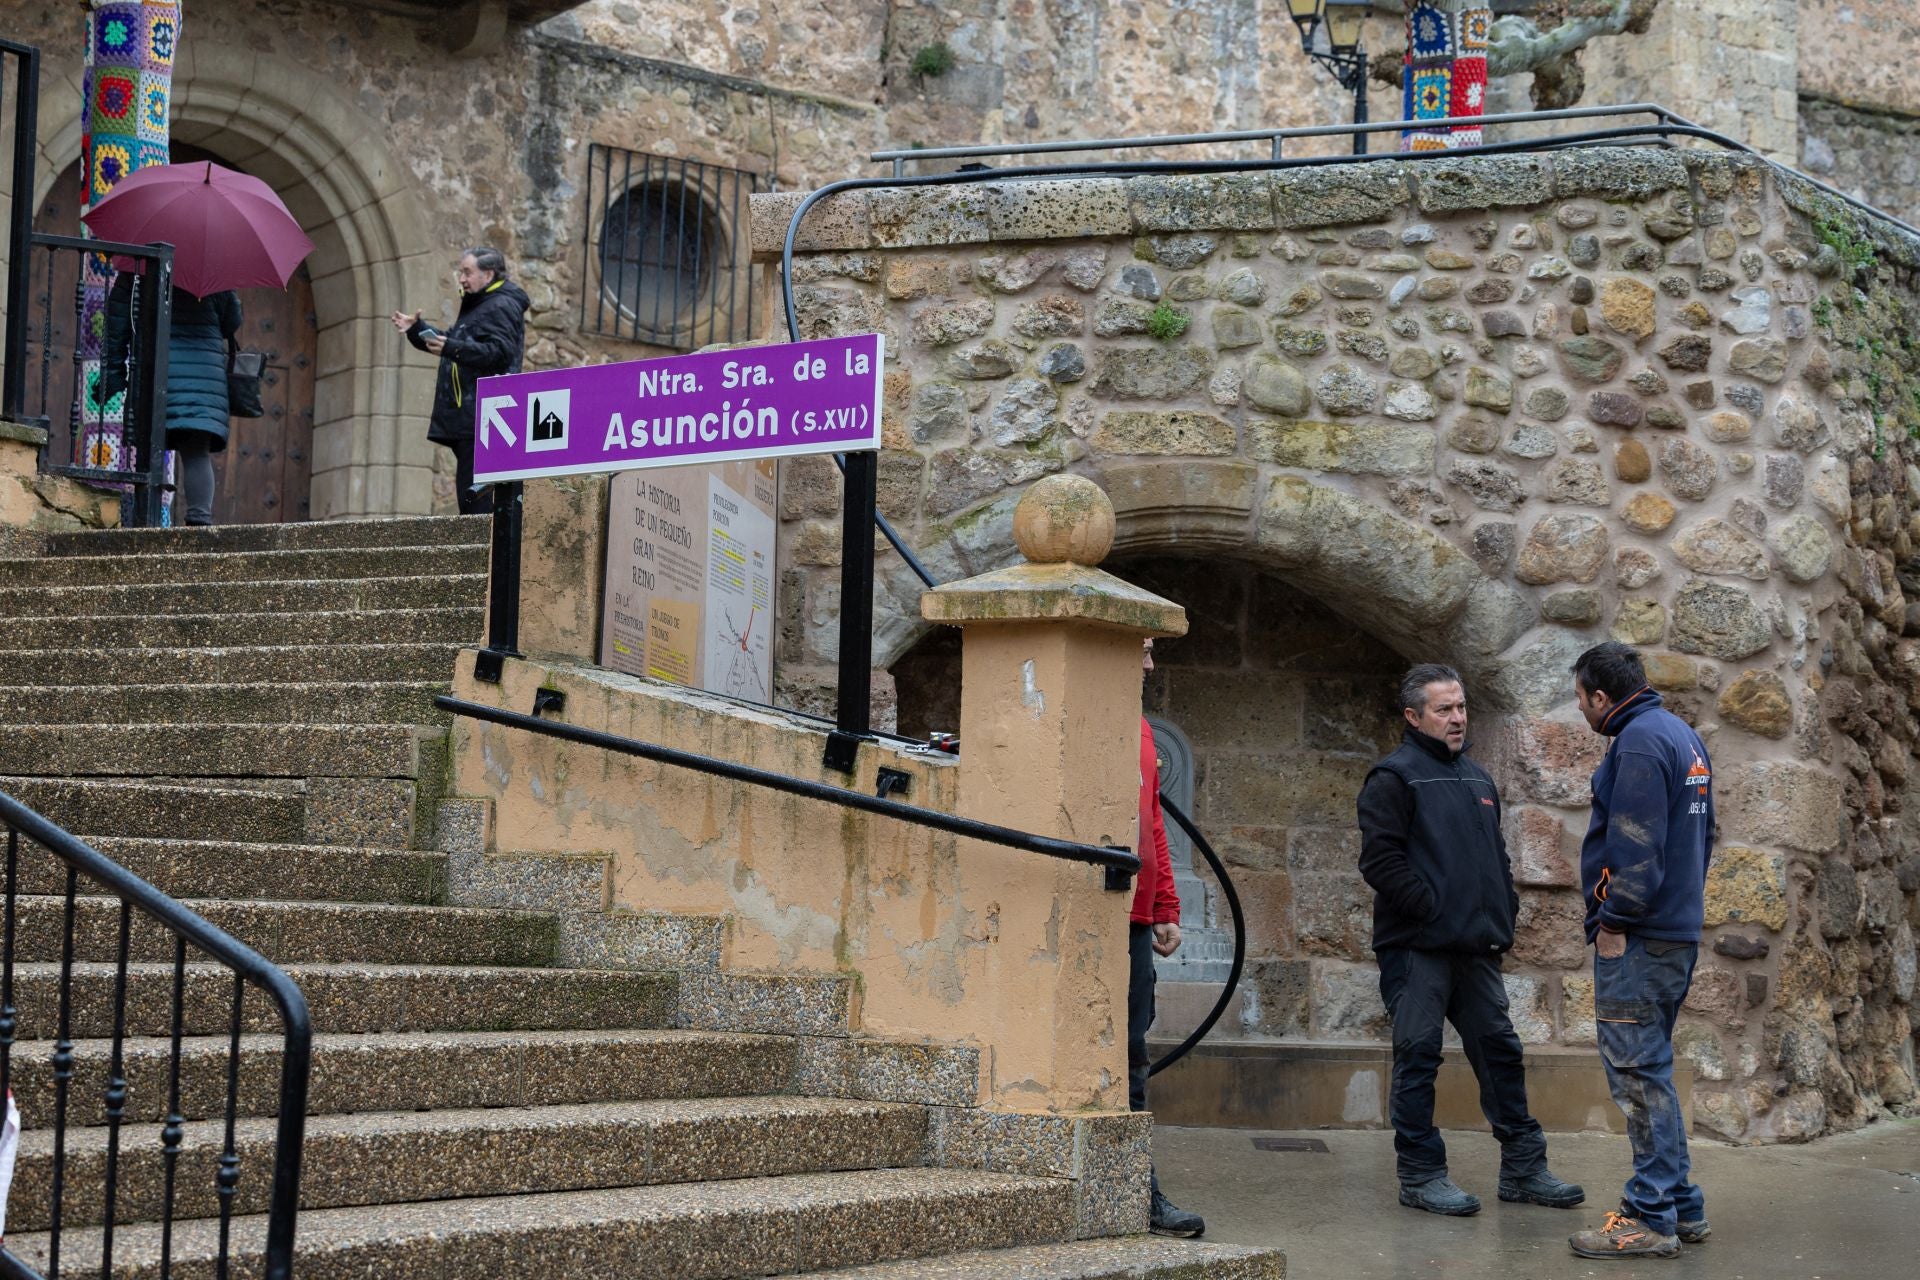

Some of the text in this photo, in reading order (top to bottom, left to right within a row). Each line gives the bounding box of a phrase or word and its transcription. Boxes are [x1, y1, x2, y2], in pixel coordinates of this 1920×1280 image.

[639, 348, 870, 398] Ntra. Sra. de la
[602, 399, 779, 452] Asunción
[636, 478, 680, 516] LA HISTORIA
[635, 507, 692, 550] DE UN PEQUEÑO
[633, 537, 655, 561] GRAN
[632, 565, 655, 591] REINO
